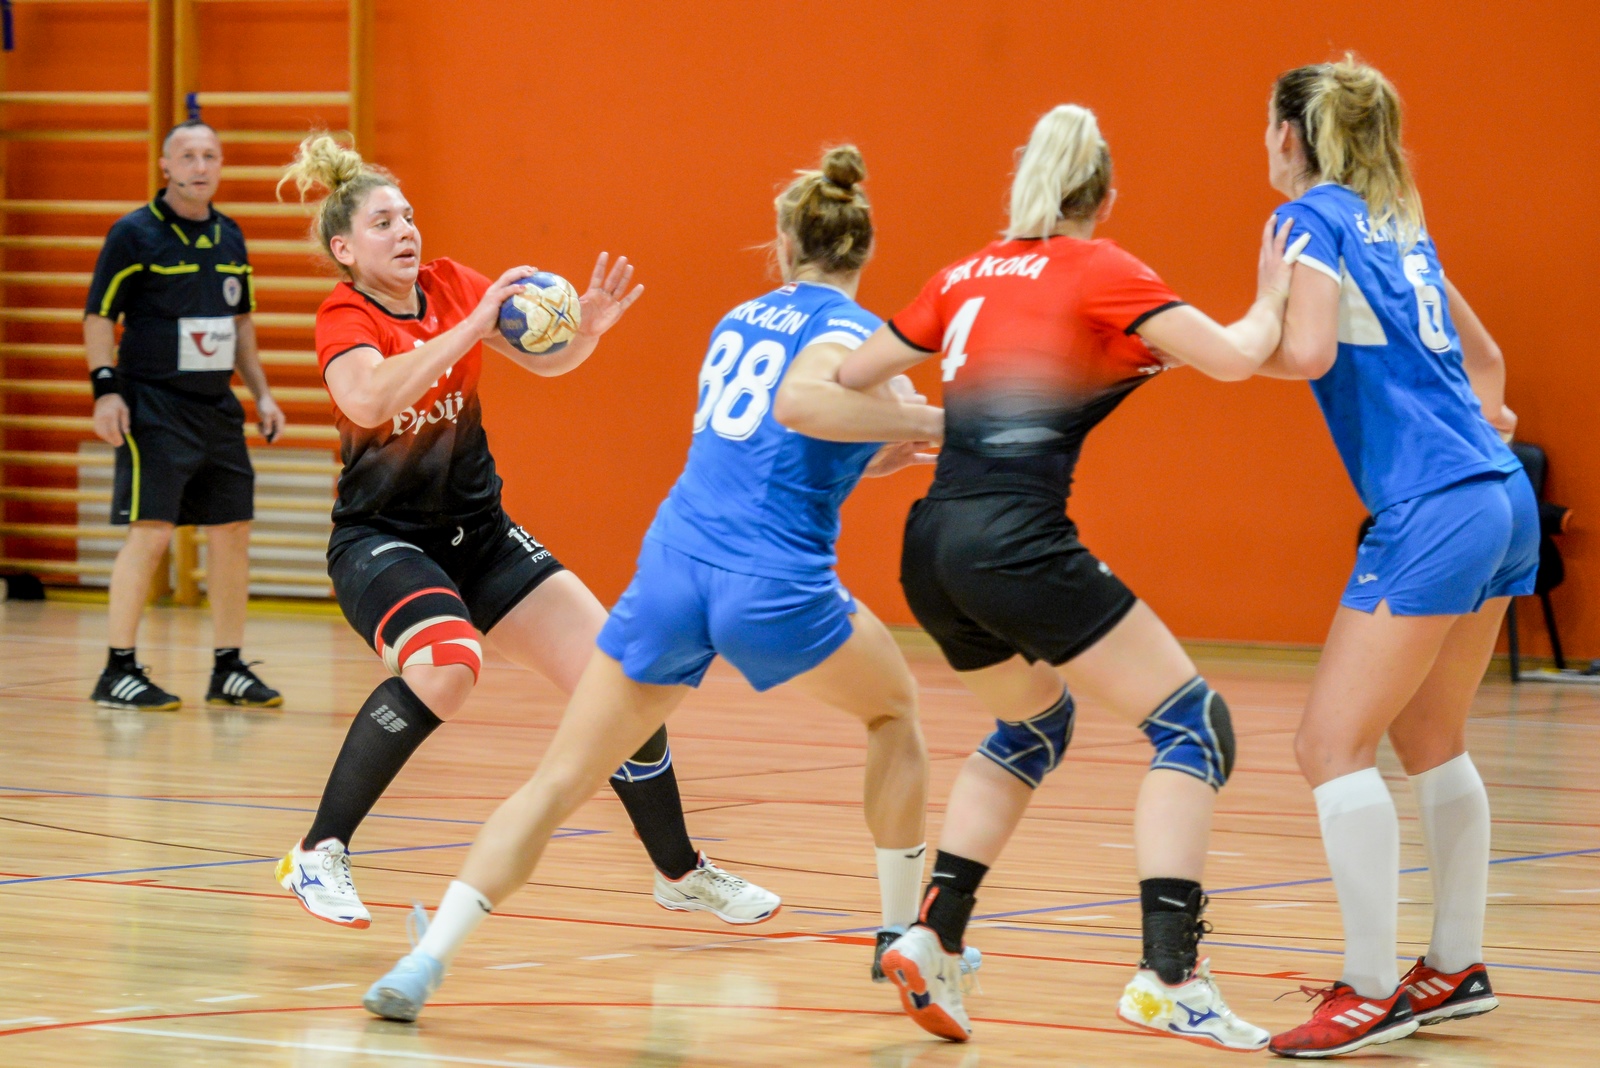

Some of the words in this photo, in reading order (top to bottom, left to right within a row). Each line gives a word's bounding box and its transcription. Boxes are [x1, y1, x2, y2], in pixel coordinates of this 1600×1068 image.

[975, 253, 1050, 280] KOKA
[1402, 253, 1452, 353] 6
[693, 329, 786, 441] 88
[941, 296, 985, 382] 4
